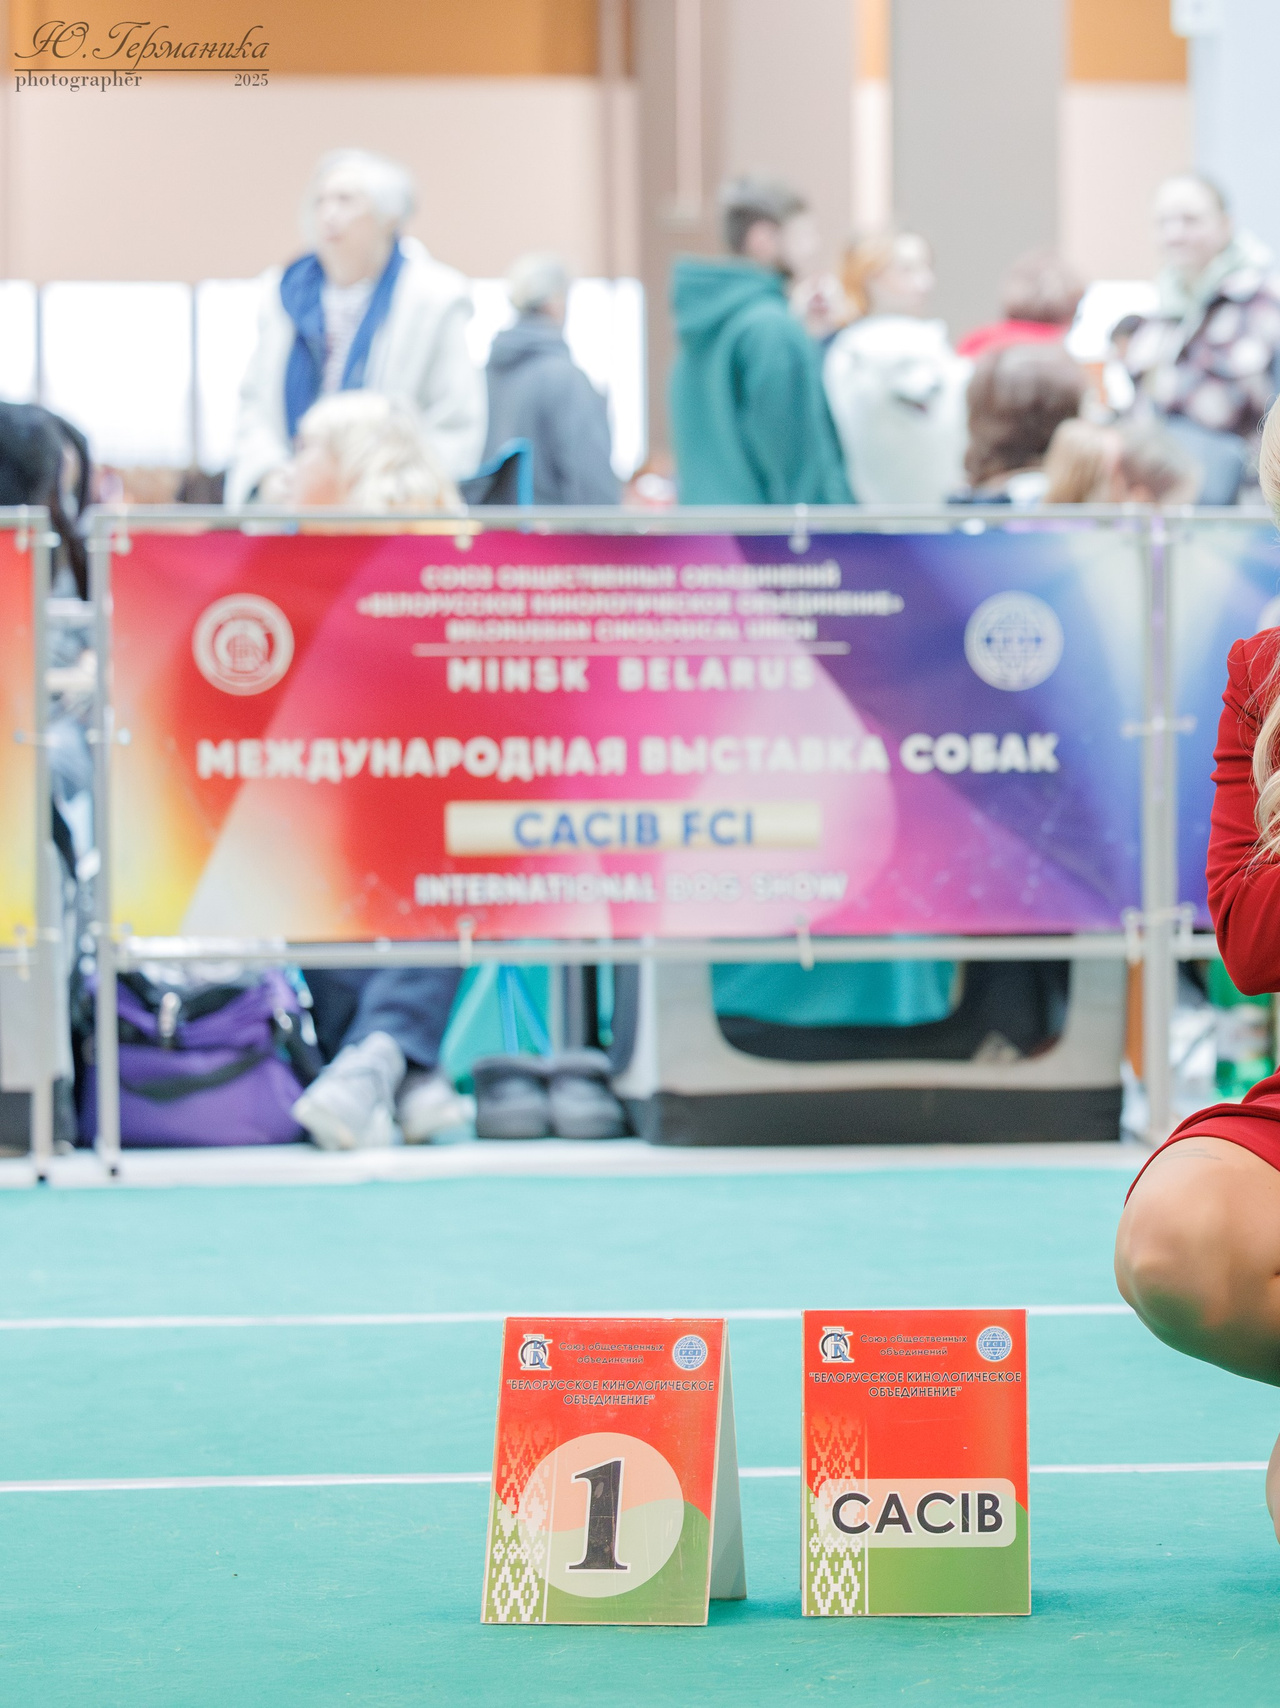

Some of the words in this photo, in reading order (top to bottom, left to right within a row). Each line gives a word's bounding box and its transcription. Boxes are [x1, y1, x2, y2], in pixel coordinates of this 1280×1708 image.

[447, 657, 590, 692] MINSK
[617, 656, 815, 690] BELARUS
[198, 736, 628, 784] МЕЖДУНАРОДНАЯ
[639, 734, 890, 776] ВЫСТАВКА
[900, 732, 1060, 774] СОБАК
[513, 811, 660, 848] CACIB
[682, 811, 755, 847] FCI
[415, 872, 655, 906] INTERNATIONAL
[667, 871, 741, 901] DOG
[752, 872, 849, 902] SHOW
[860, 1334, 887, 1343] Союз
[601, 1380, 714, 1392] КИНОЛОГИЧЕСКОЕ
[906, 1371, 1021, 1383] КИНОЛОГИЧЕСКОЕ
[567, 1458, 630, 1572] 1
[832, 1491, 1003, 1535] CACIB
